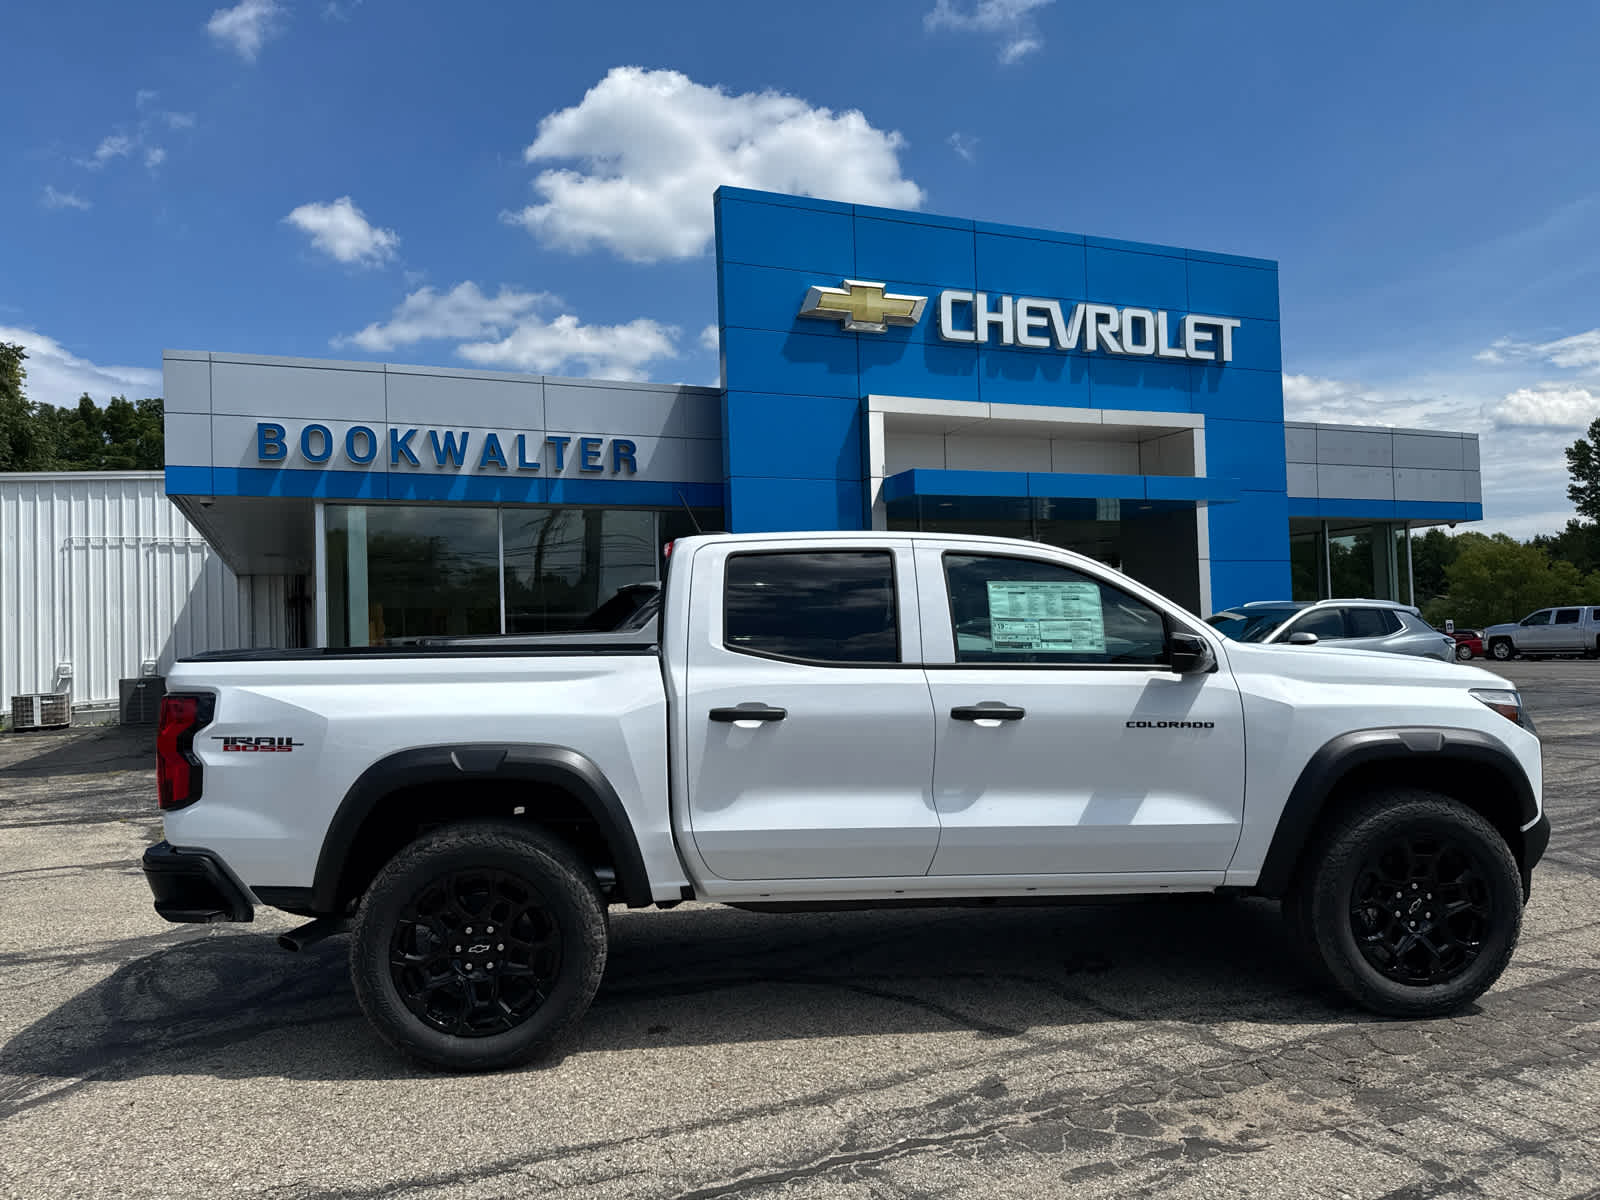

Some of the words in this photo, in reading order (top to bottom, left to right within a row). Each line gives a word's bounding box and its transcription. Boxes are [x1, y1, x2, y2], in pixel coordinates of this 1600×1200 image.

[938, 289, 1241, 363] CHEVROLET
[256, 422, 638, 474] BOOKWALTER
[210, 736, 304, 746] TRAIL
